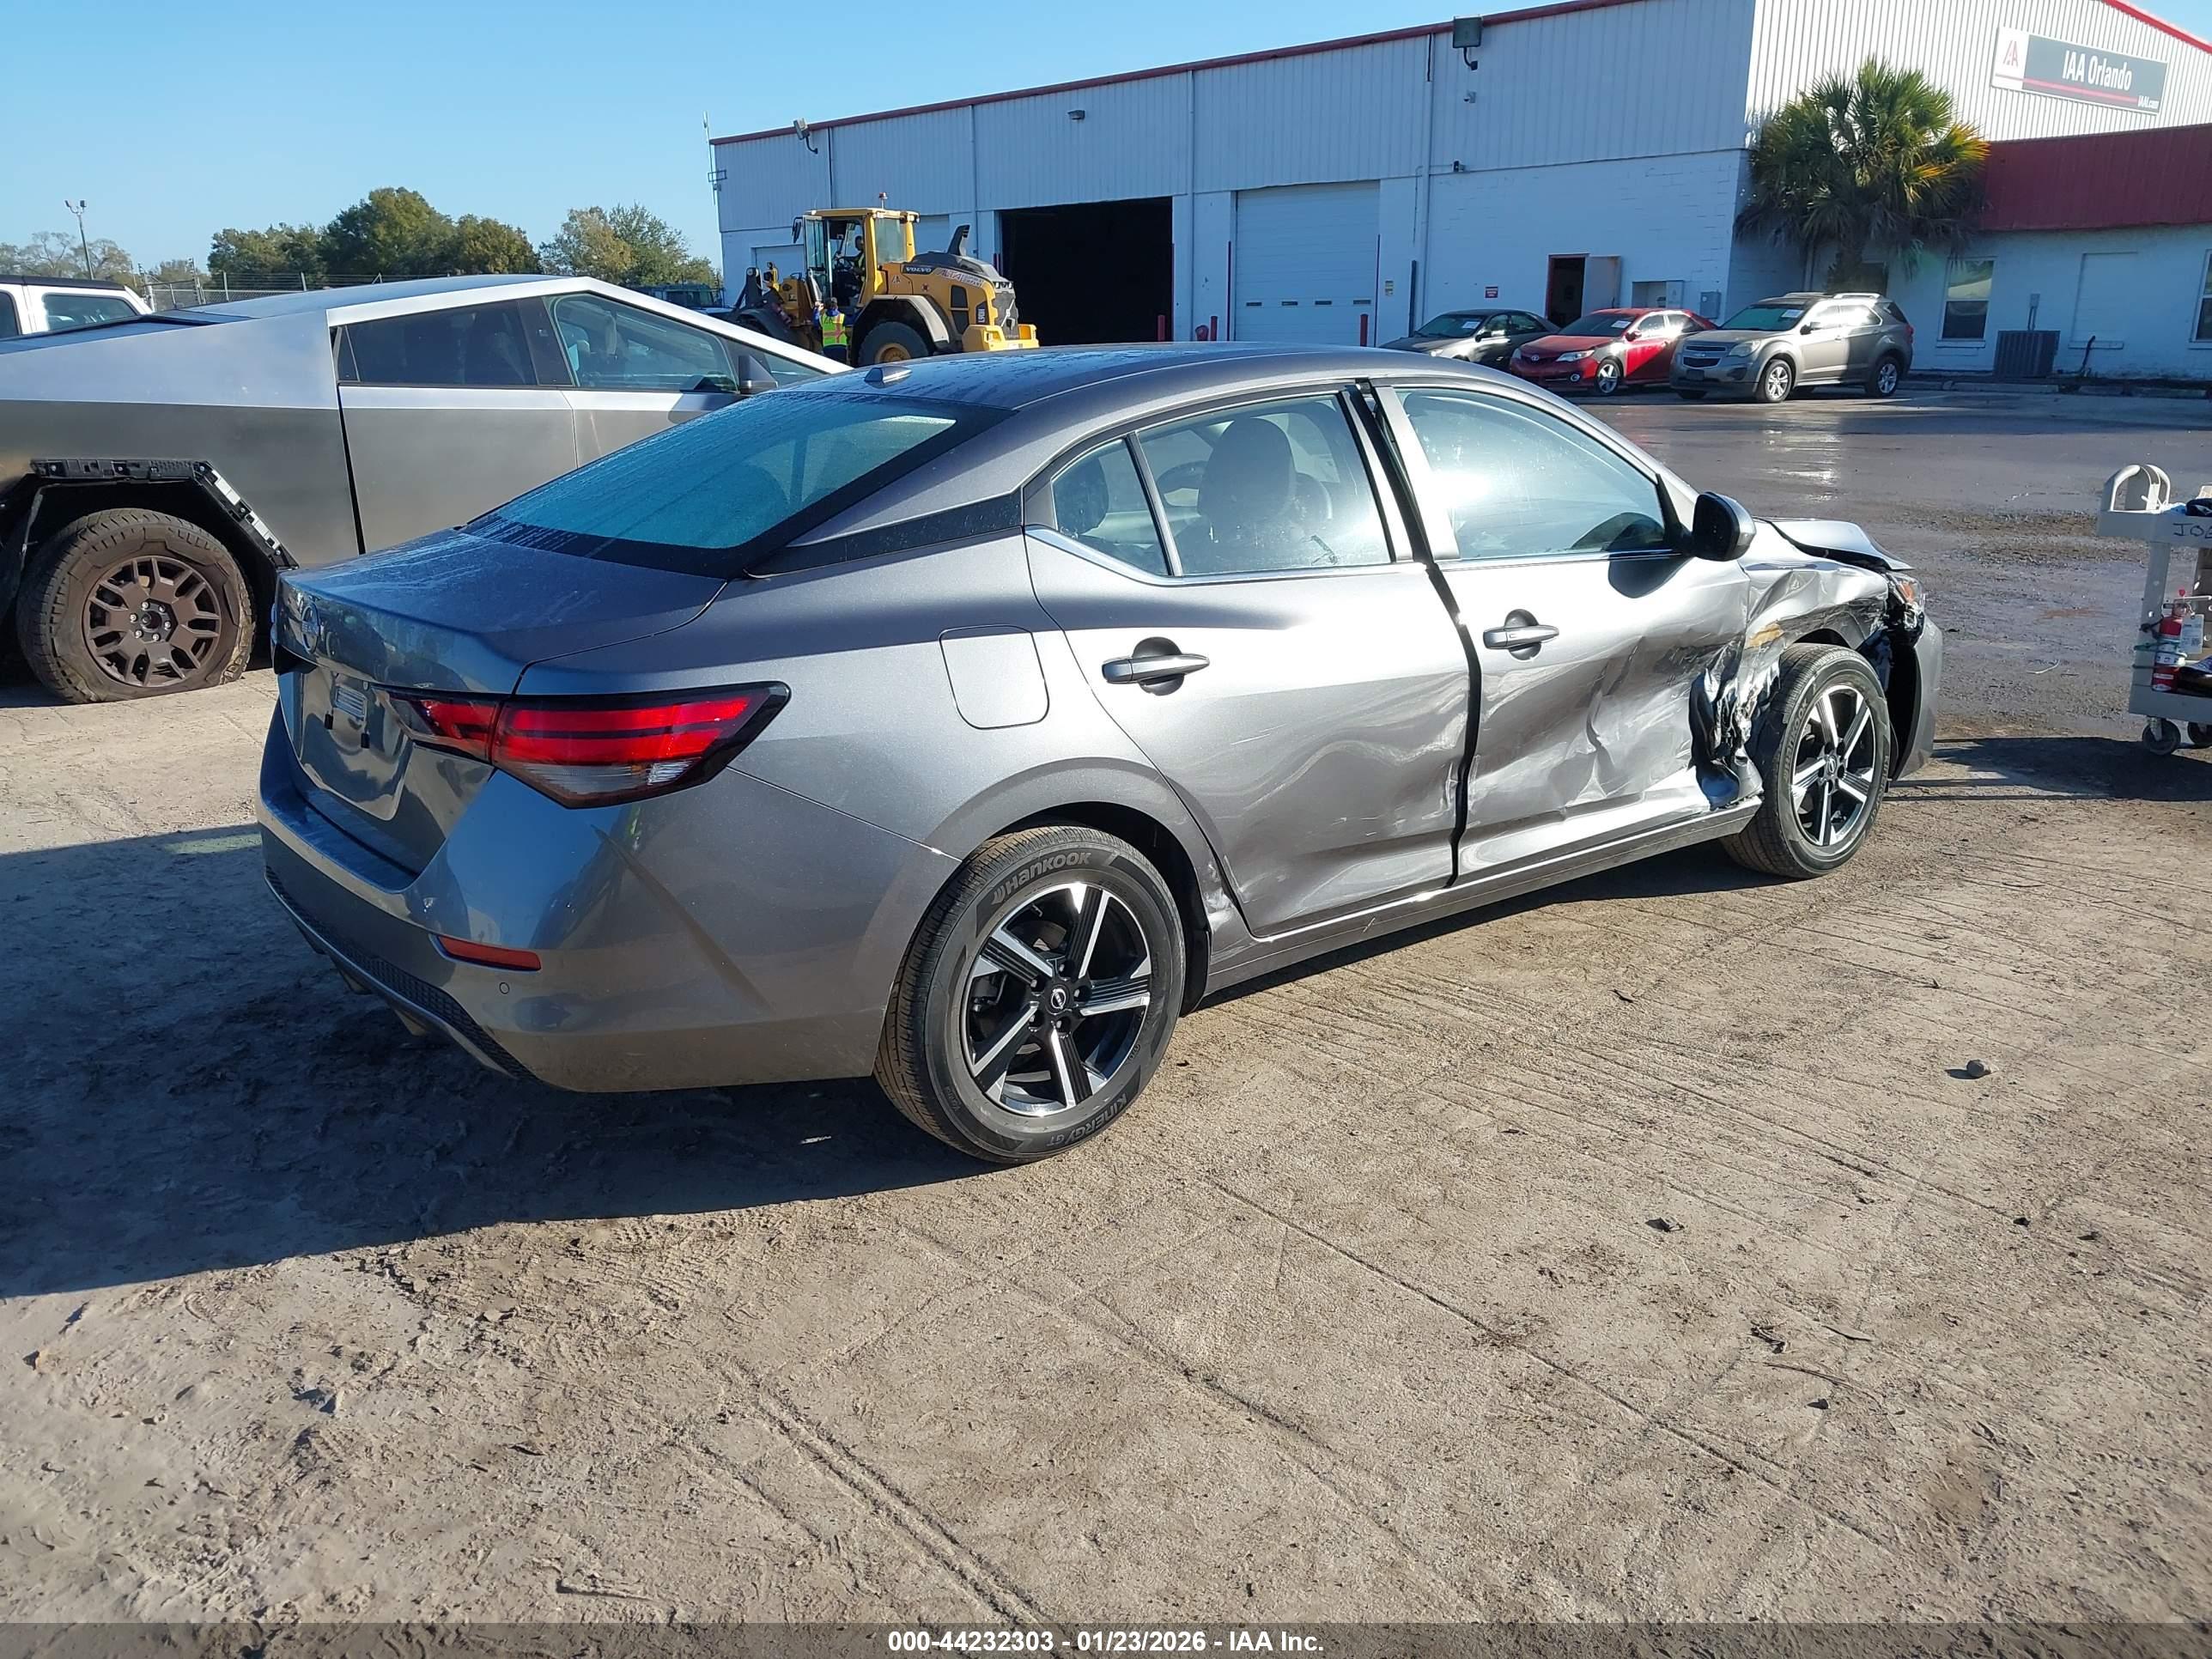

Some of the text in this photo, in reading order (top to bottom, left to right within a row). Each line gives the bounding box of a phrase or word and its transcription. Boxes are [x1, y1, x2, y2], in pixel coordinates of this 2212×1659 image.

[2062, 49, 2132, 91] IAA Orlando
[1045, 1133, 1066, 1147] GT
